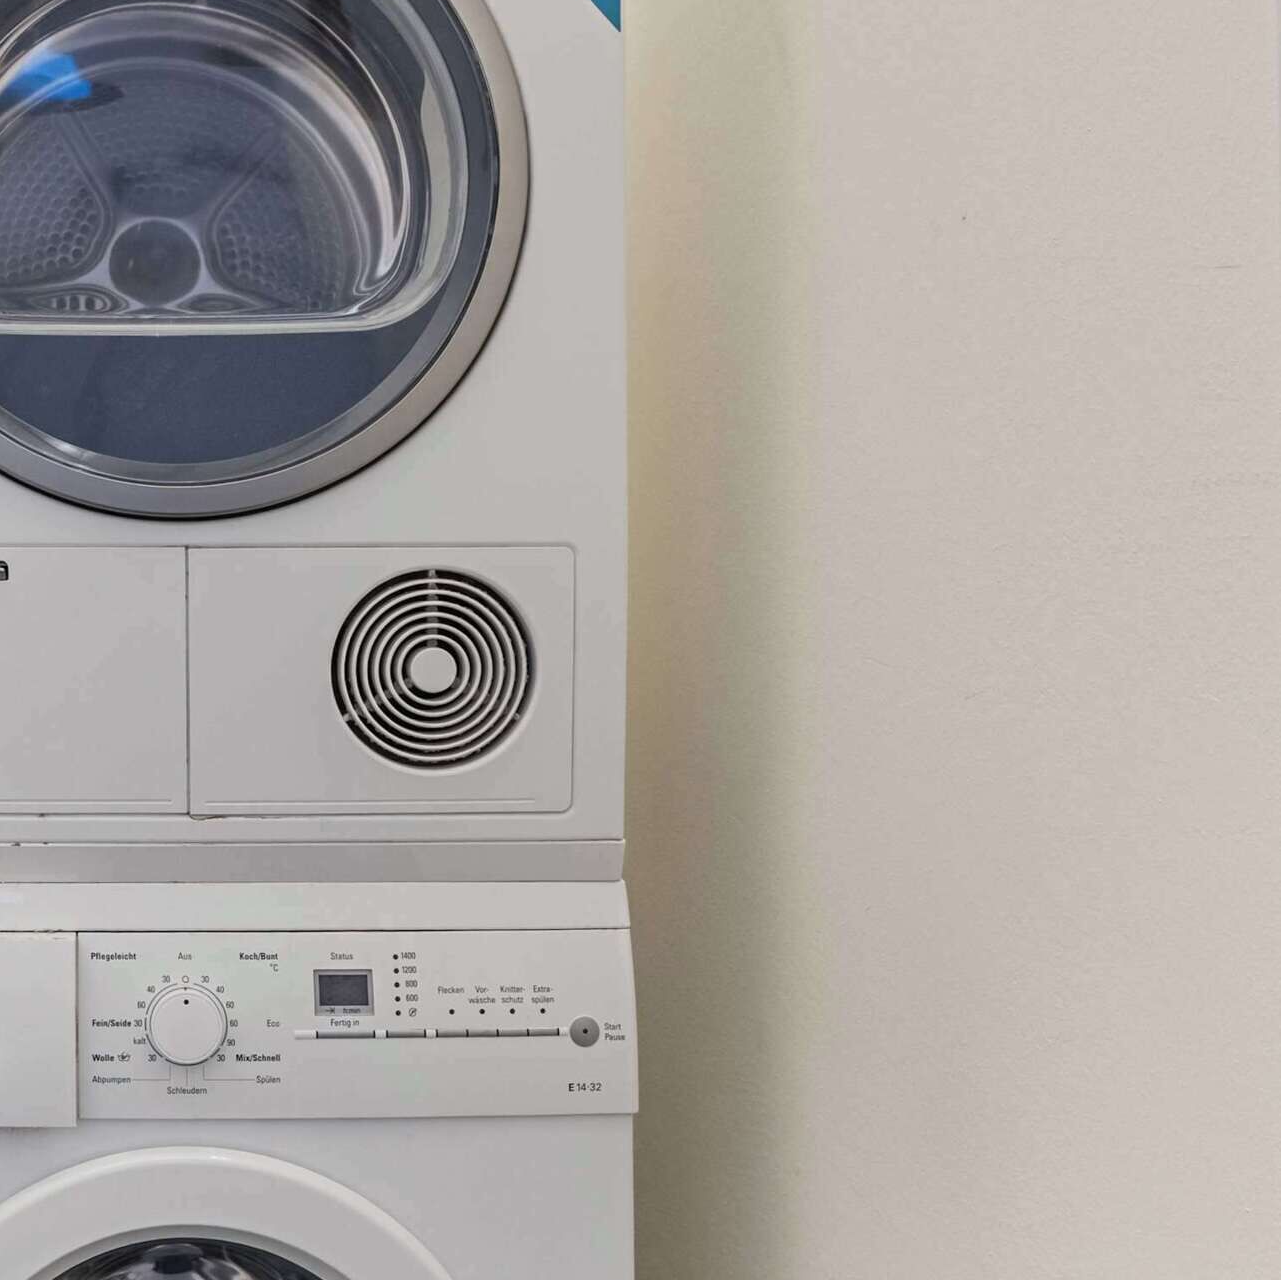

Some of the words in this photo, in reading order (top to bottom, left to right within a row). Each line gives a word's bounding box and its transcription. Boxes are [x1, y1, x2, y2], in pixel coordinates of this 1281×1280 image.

[90, 952, 137, 962] Pflegeleicht
[178, 952, 192, 960] Aus
[239, 952, 279, 961] Koch/Bunt
[330, 952, 354, 960] Status
[401, 952, 416, 960] 1400
[402, 966, 417, 974] 1200
[162, 976, 171, 984] 30
[201, 976, 210, 984] 30
[405, 980, 418, 988] 800
[147, 985, 156, 994] 40
[216, 985, 225, 994] 40
[438, 986, 465, 994] Flecken
[500, 985, 525, 993] Knitter-
[533, 985, 554, 993] Extra-
[405, 994, 419, 1002] 600
[468, 996, 496, 1004] wäsche
[501, 996, 524, 1004] schutz
[531, 996, 555, 1005] spülen
[225, 1001, 235, 1009] 60
[92, 1019, 132, 1028] Fein/Seide
[133, 1019, 143, 1028] 30
[229, 1019, 239, 1028] 60
[266, 1019, 280, 1028] Eco
[330, 1018, 352, 1028] Fertig
[352, 1019, 360, 1027] in
[604, 1022, 622, 1031] Start
[133, 1036, 146, 1045] kalt
[605, 1032, 626, 1041] Pause
[226, 1038, 236, 1047] 90
[91, 1053, 115, 1062] Wolle
[148, 1054, 157, 1062] 30
[216, 1054, 226, 1062] 30
[236, 1053, 281, 1062] Mix/Schnell
[92, 1075, 131, 1085] Abpumpen
[256, 1074, 281, 1084] Spülen
[166, 1086, 208, 1095] Schleudern
[568, 1083, 575, 1092] E
